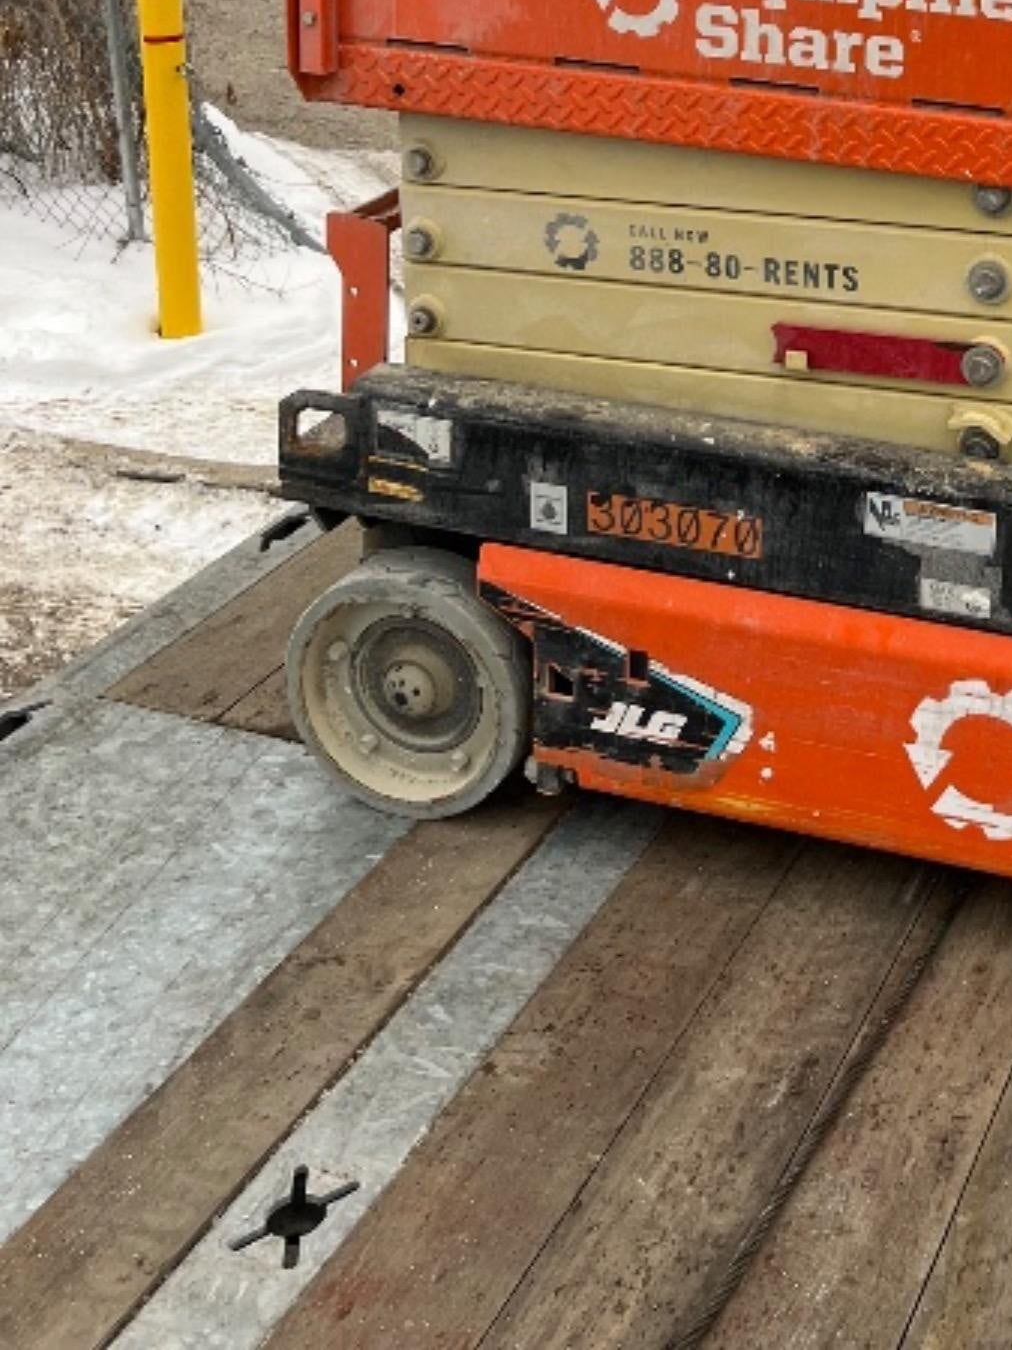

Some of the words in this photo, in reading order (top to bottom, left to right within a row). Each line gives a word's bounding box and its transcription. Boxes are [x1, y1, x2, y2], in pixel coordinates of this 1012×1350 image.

[694, 2, 905, 79] Share
[628, 224, 667, 241] CALL
[589, 493, 760, 556] 303070
[590, 701, 688, 740] JLG
